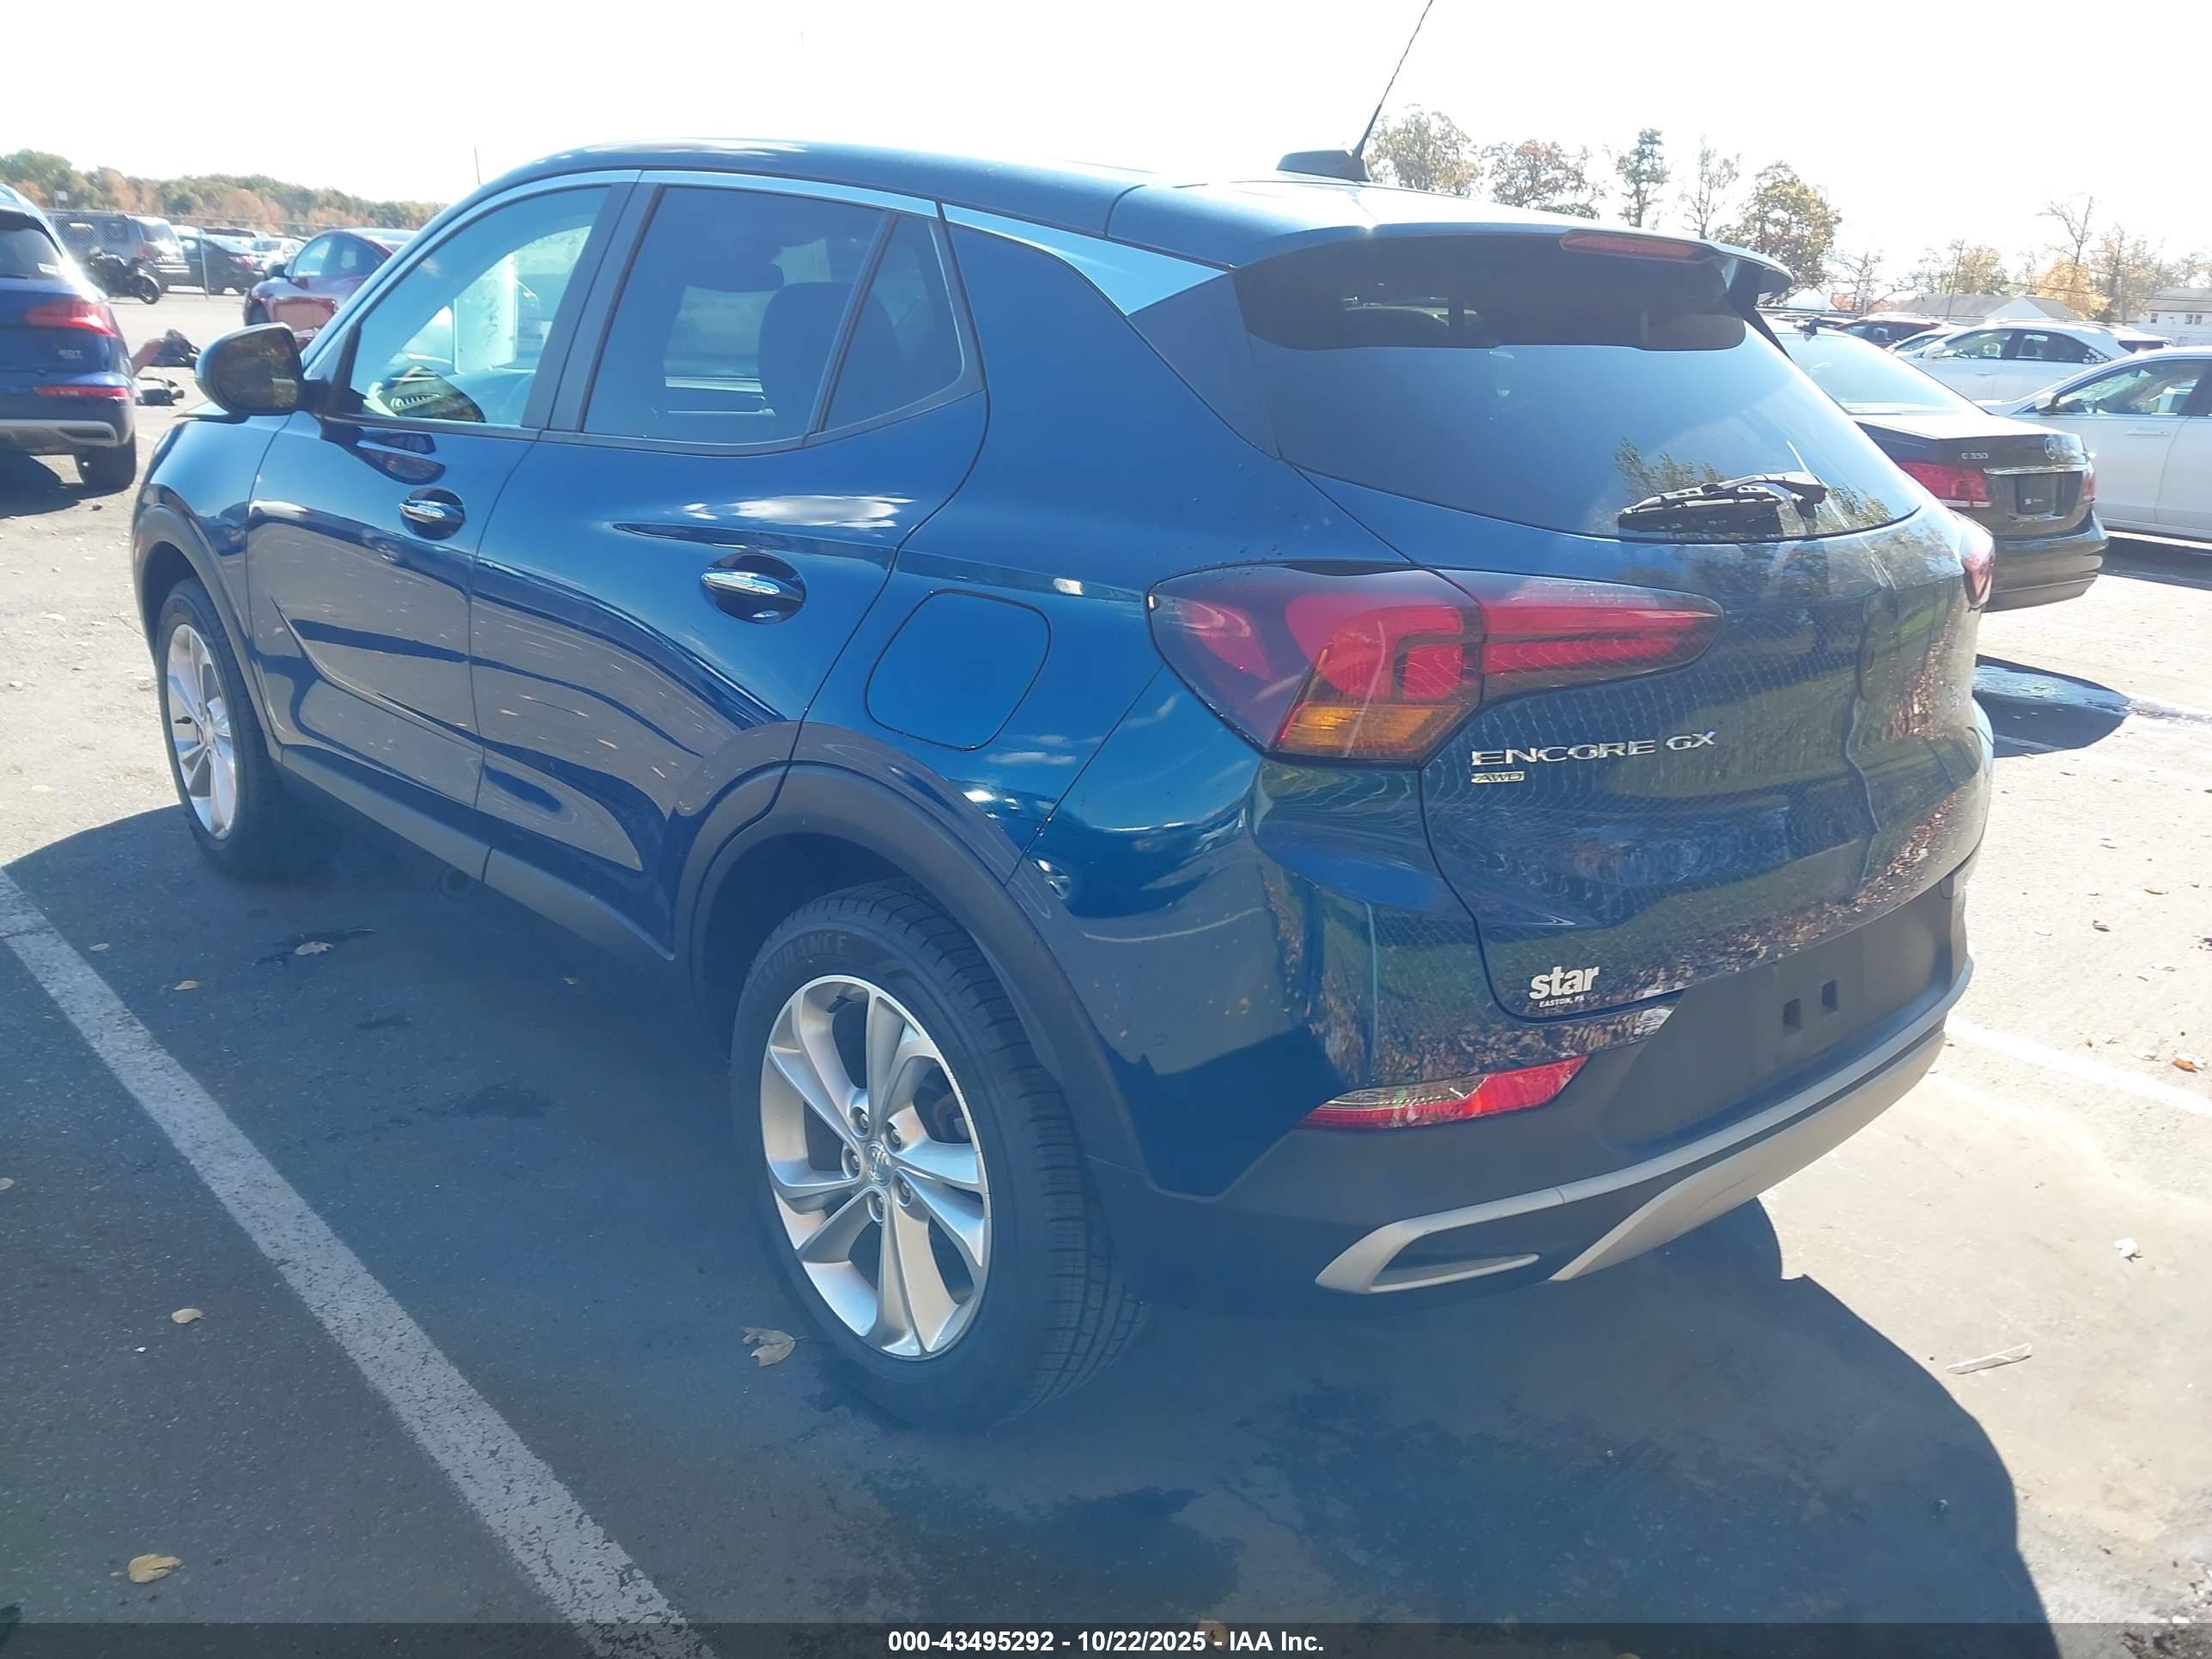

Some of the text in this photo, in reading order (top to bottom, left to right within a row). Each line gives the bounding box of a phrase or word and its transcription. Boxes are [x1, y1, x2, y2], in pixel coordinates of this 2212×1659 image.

[1471, 731, 1717, 766] ENCORE GX
[1476, 773, 1522, 782] AWD
[1529, 966, 1600, 1000] star
